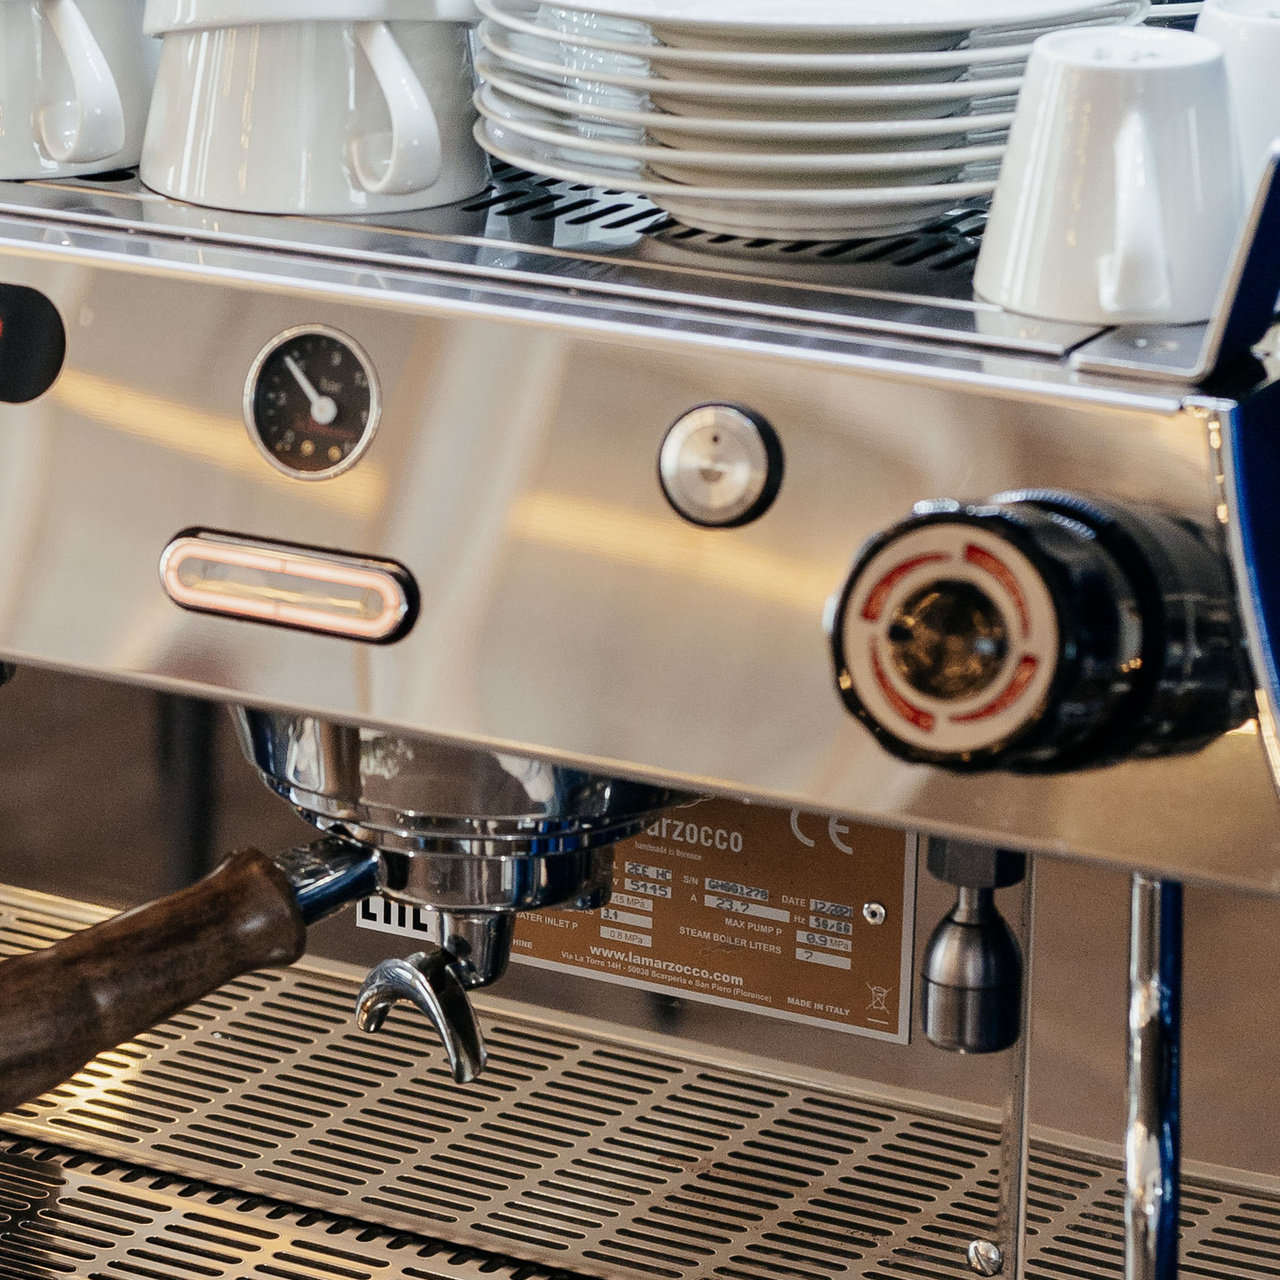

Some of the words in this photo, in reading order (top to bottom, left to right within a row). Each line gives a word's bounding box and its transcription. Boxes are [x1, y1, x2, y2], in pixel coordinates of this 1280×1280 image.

[645, 818, 743, 853] arzocco
[683, 875, 699, 885] S/N
[690, 894, 698, 902] A
[716, 897, 749, 913] 23.7
[781, 895, 806, 907] DATE
[544, 916, 570, 929] INLET
[725, 917, 745, 929] MAX
[747, 922, 774, 934] PUMP
[679, 926, 710, 940] STEAM
[713, 933, 747, 948] BOILER
[749, 942, 781, 955] LITERS
[561, 950, 573, 960] Via
[575, 953, 584, 962] La
[695, 979, 710, 989] San
[589, 944, 744, 987] www.lamarzocco.com
[787, 996, 811, 1009] MADE
[814, 1002, 824, 1011] IN
[826, 1005, 850, 1017] ITALY
